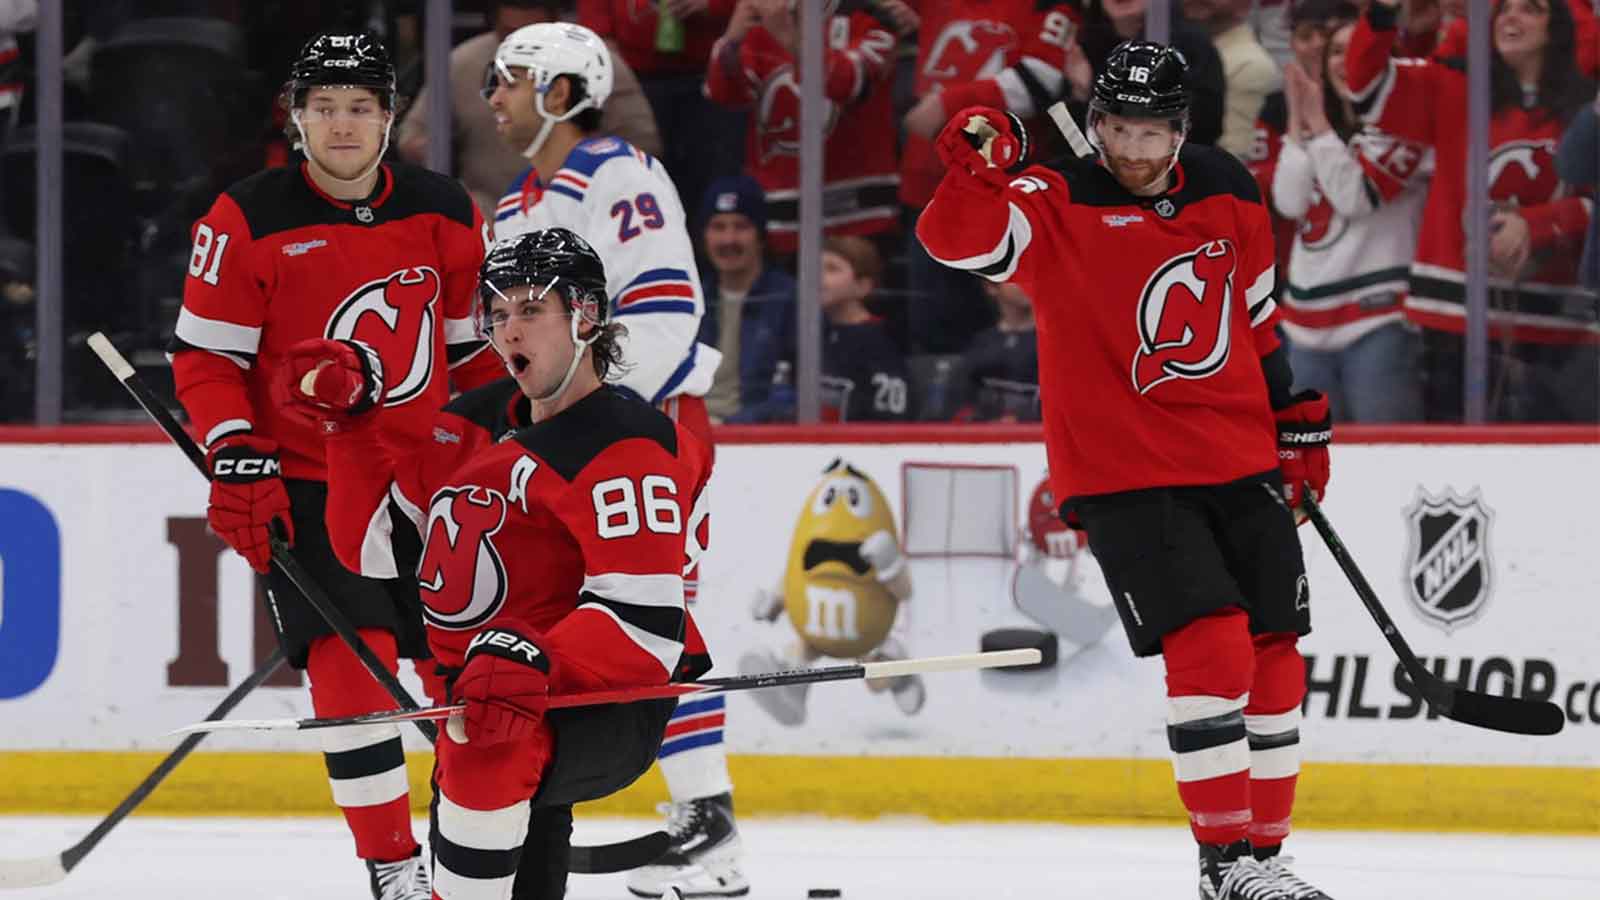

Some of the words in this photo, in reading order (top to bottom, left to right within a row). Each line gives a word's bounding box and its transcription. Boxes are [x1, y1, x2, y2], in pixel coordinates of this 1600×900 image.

[323, 59, 360, 69] CCM
[1127, 65, 1150, 84] 16
[1116, 93, 1152, 104] CCM
[610, 191, 665, 243] 29
[188, 222, 229, 286] 81
[871, 372, 907, 414] 20
[214, 458, 281, 475] CCM
[507, 453, 539, 515] A
[591, 474, 682, 539] 86
[1420, 524, 1478, 601] NHL
[804, 583, 859, 640] m
